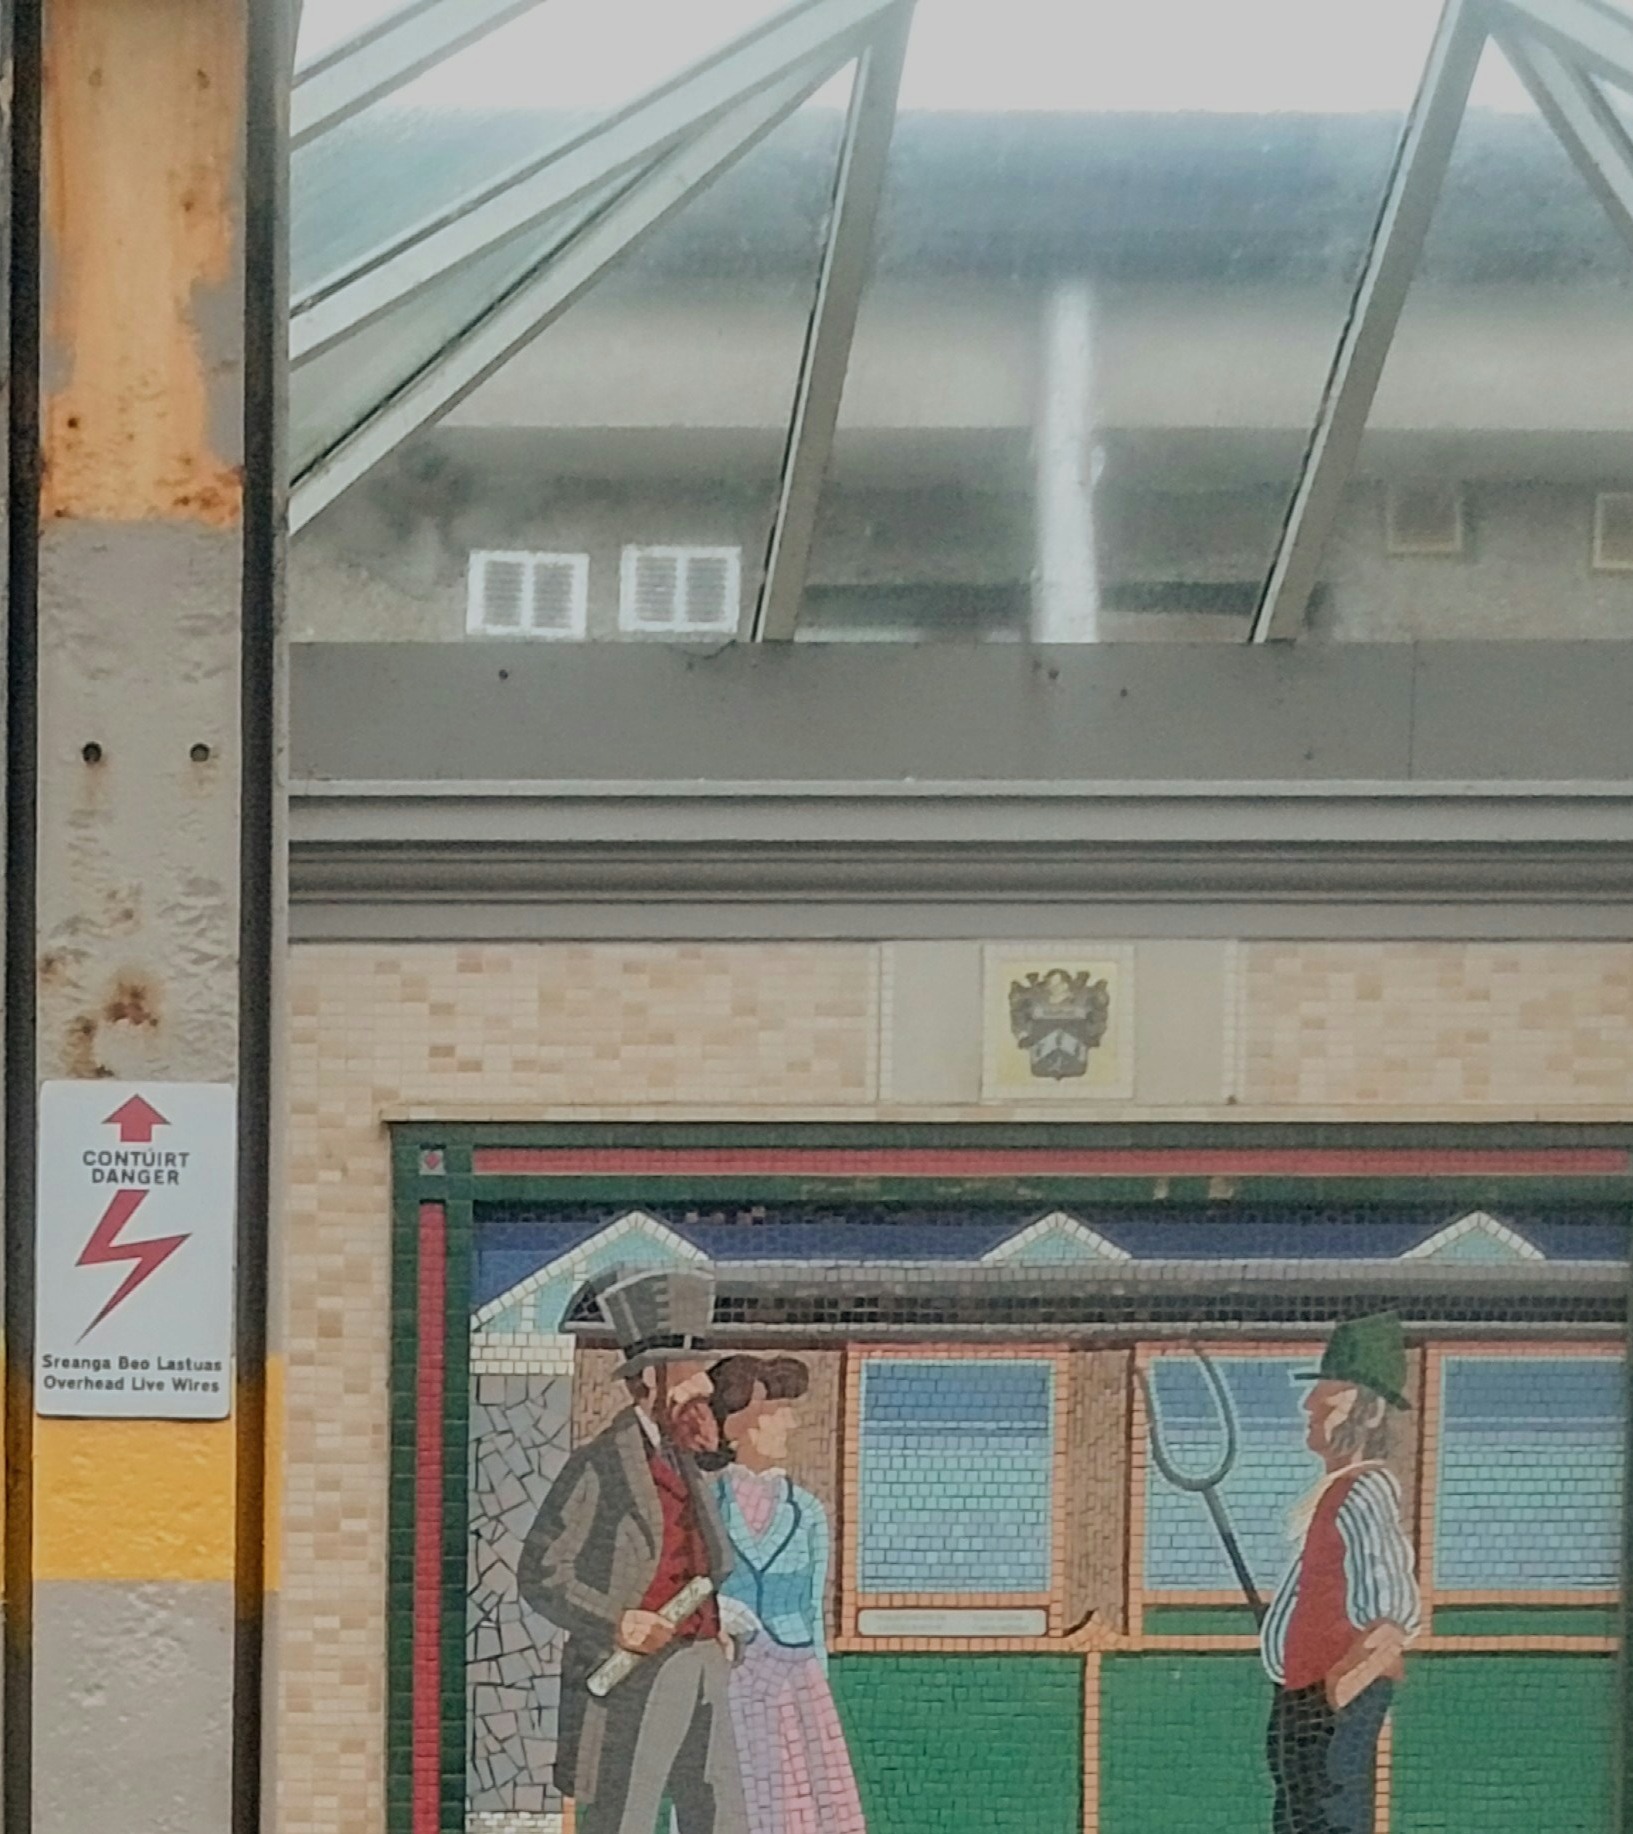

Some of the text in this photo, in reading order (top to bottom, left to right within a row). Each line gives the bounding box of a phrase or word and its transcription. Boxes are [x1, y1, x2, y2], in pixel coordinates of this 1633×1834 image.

[82, 1147, 190, 1168] CONTÚIRT
[92, 1168, 180, 1185] DANGER
[42, 1354, 222, 1372] Sreanga Beo Lastuas
[43, 1375, 220, 1393] Overhead Live Wires
